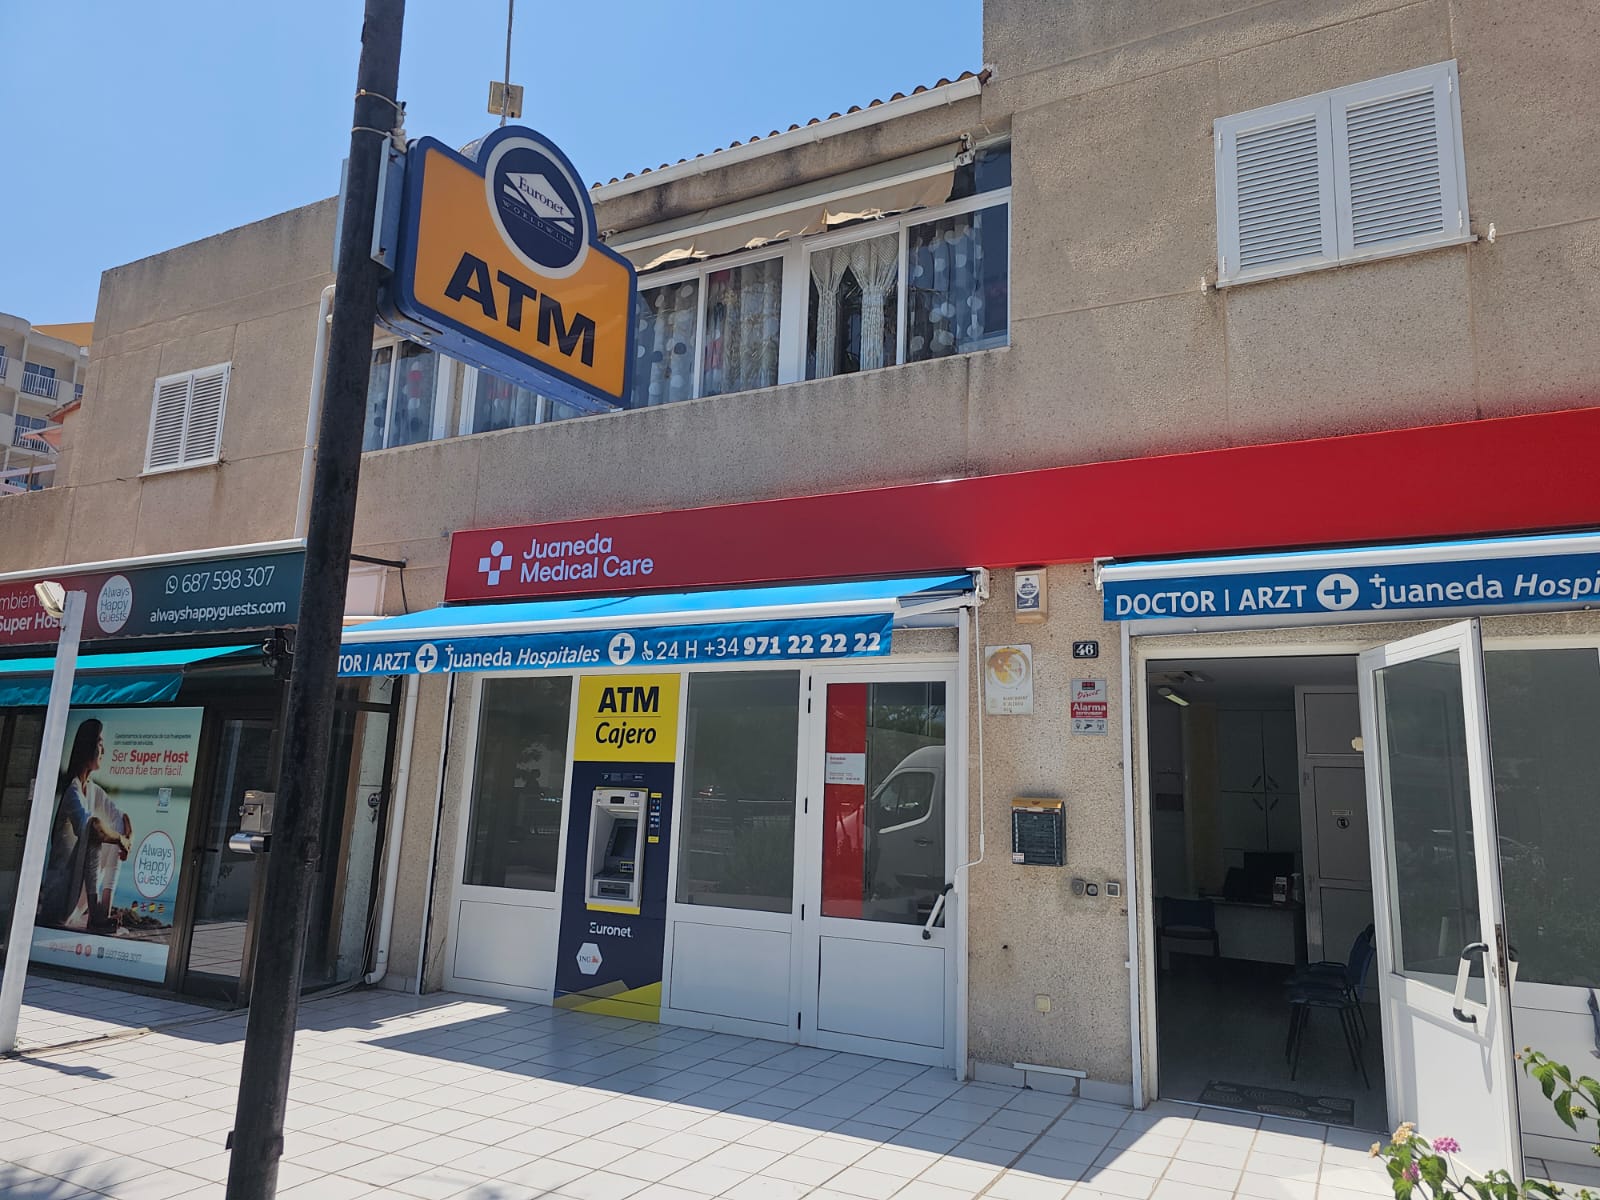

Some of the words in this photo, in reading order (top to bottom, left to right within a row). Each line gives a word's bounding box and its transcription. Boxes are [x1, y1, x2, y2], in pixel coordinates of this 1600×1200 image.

[518, 176, 564, 216] Euronet
[444, 251, 596, 368] ATM
[522, 532, 613, 560] Juaneda
[602, 555, 655, 578] Care
[181, 572, 211, 593] 687
[212, 569, 242, 591] 598
[243, 565, 276, 588] 307
[102, 586, 130, 599] Always
[1115, 590, 1217, 616] DOCTOR
[1238, 585, 1308, 612] ARZT
[1369, 573, 1504, 609] juaneda
[99, 611, 128, 623] Guests
[100, 599, 129, 613] Happy
[150, 601, 286, 624] alwayshappyguests.com
[656, 641, 679, 660] 24
[685, 640, 698, 659] H
[704, 637, 740, 657] +34
[743, 636, 781, 656] 971
[788, 634, 815, 655] 22
[820, 633, 847, 654] 22
[854, 632, 881, 653] 22
[1076, 644, 1095, 657] 46
[373, 651, 411, 672] ARZT
[442, 644, 512, 672] juaneda
[515, 645, 600, 669] Hospitales
[597, 686, 660, 713] ATM
[1072, 702, 1107, 712] Alarma
[595, 721, 657, 749] Cajero
[112, 749, 129, 762] Ser
[130, 749, 162, 765] Super
[163, 750, 189, 763] Host
[109, 765, 134, 775] nunca
[135, 765, 149, 775] fue
[150, 765, 163, 775] tan
[141, 844, 173, 859] Always
[138, 857, 171, 874] Happy
[137, 871, 168, 886] Guests
[589, 922, 632, 938] Euronet
